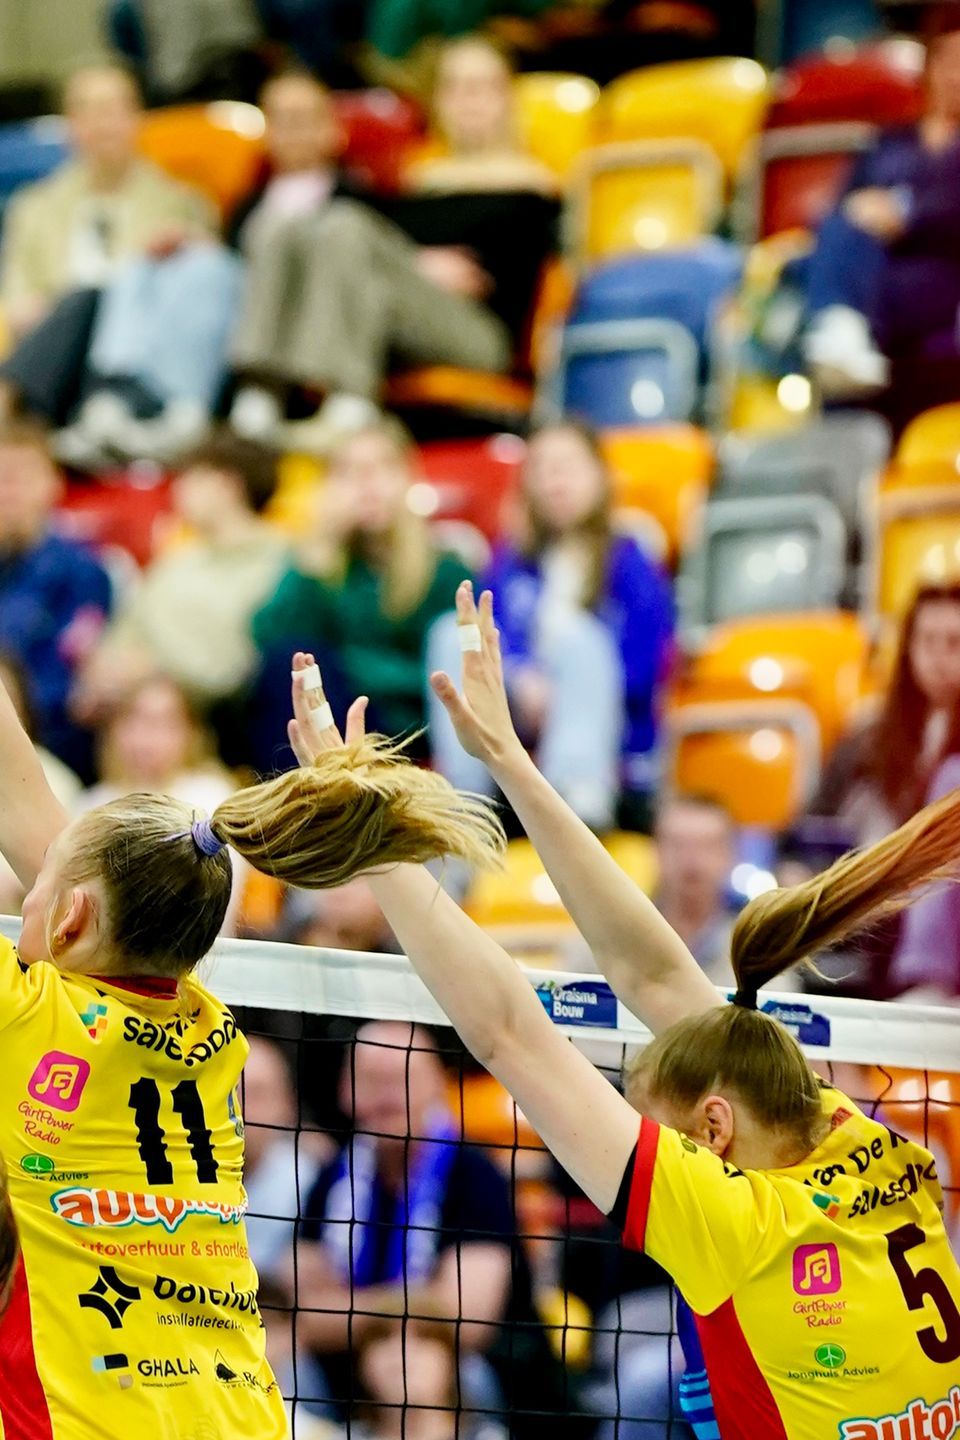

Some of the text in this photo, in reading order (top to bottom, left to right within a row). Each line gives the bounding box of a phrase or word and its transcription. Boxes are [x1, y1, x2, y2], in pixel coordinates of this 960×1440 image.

[553, 986, 598, 1005] Draisma
[553, 1001, 585, 1018] Bouw
[18, 1100, 75, 1132] GirlPower
[24, 1120, 61, 1145] Radio
[127, 1076, 219, 1185] 11
[848, 1137, 884, 1174] De
[82, 1240, 186, 1257] utoverhuur
[191, 1242, 202, 1257] &
[884, 1222, 960, 1364] 5
[793, 1299, 848, 1315] GirlPower
[806, 1315, 843, 1329] Radio
[137, 1357, 200, 1378] GHALA
[842, 1365, 880, 1378] Advies
